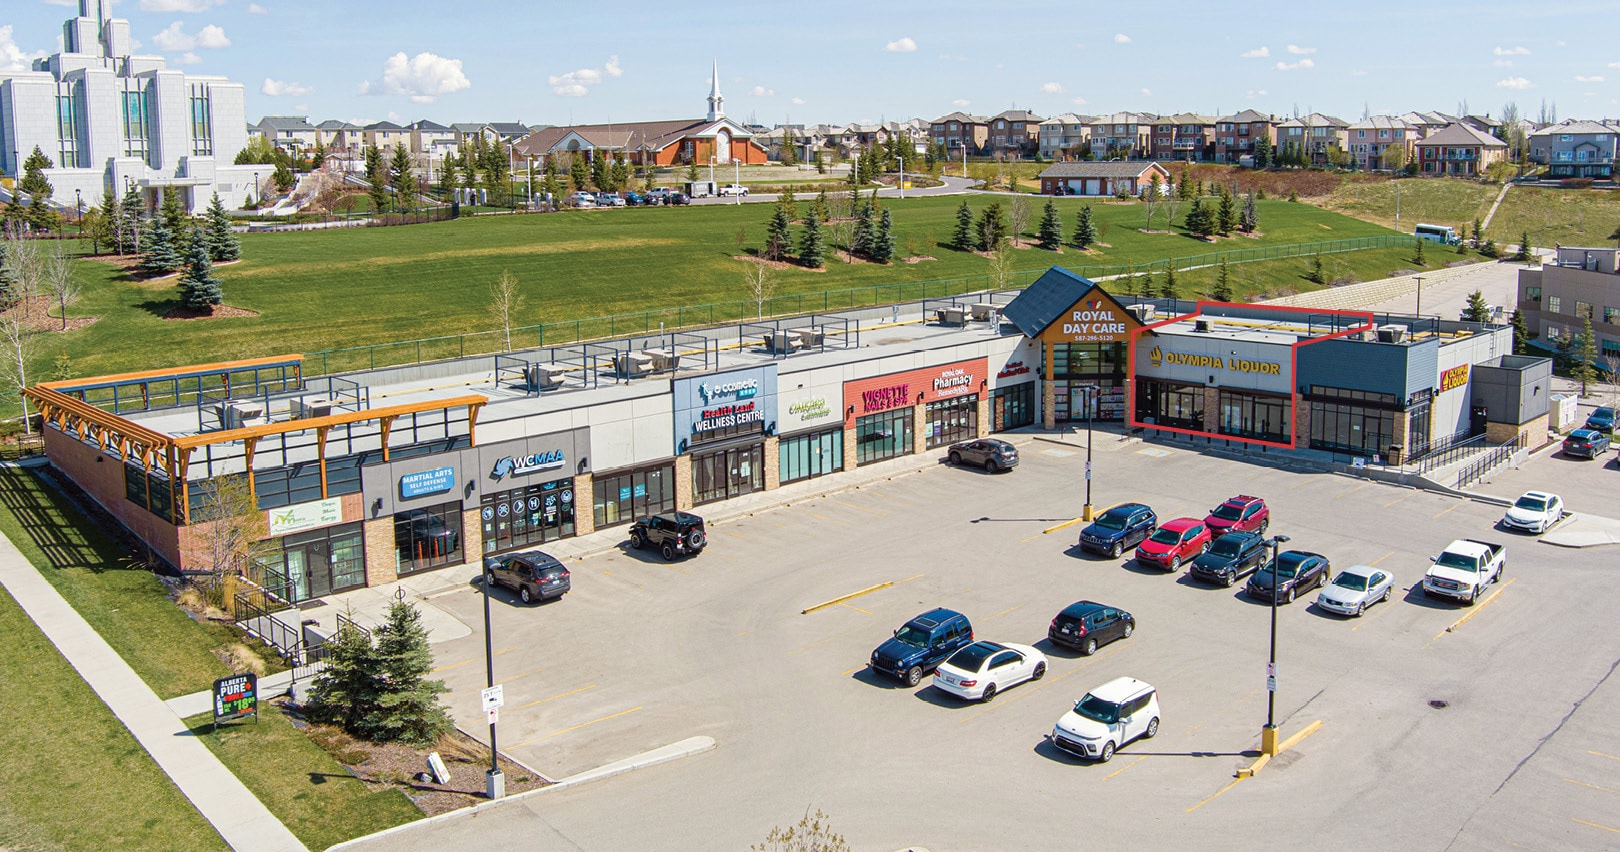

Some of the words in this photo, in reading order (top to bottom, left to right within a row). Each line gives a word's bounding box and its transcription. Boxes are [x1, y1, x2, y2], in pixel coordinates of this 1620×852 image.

[1073, 311, 1115, 321] ROYAL
[1063, 323, 1089, 334] DAY
[1092, 323, 1126, 334] CARE
[1165, 352, 1223, 369] OLYMPIA
[1228, 359, 1280, 375] LIQUOR
[722, 379, 758, 392] cosmetic
[934, 374, 973, 390] Pharmacy
[1448, 373, 1468, 389] LIQUOR
[864, 384, 909, 401] VIGNETTE
[703, 407, 732, 419] Health
[734, 401, 755, 414] Land
[865, 399, 887, 411] NAILS
[895, 395, 909, 405] SPA
[695, 414, 735, 432] WELLNESS
[736, 410, 764, 424] CENTRE
[512, 448, 565, 468] WCMAA
[403, 473, 433, 483] MARTIAL
[434, 469, 453, 478] ARTS
[409, 480, 423, 489] SELF
[423, 477, 447, 487] DEFENSE
[220, 682, 246, 697] PURE
[221, 676, 248, 687] ALBERTA
